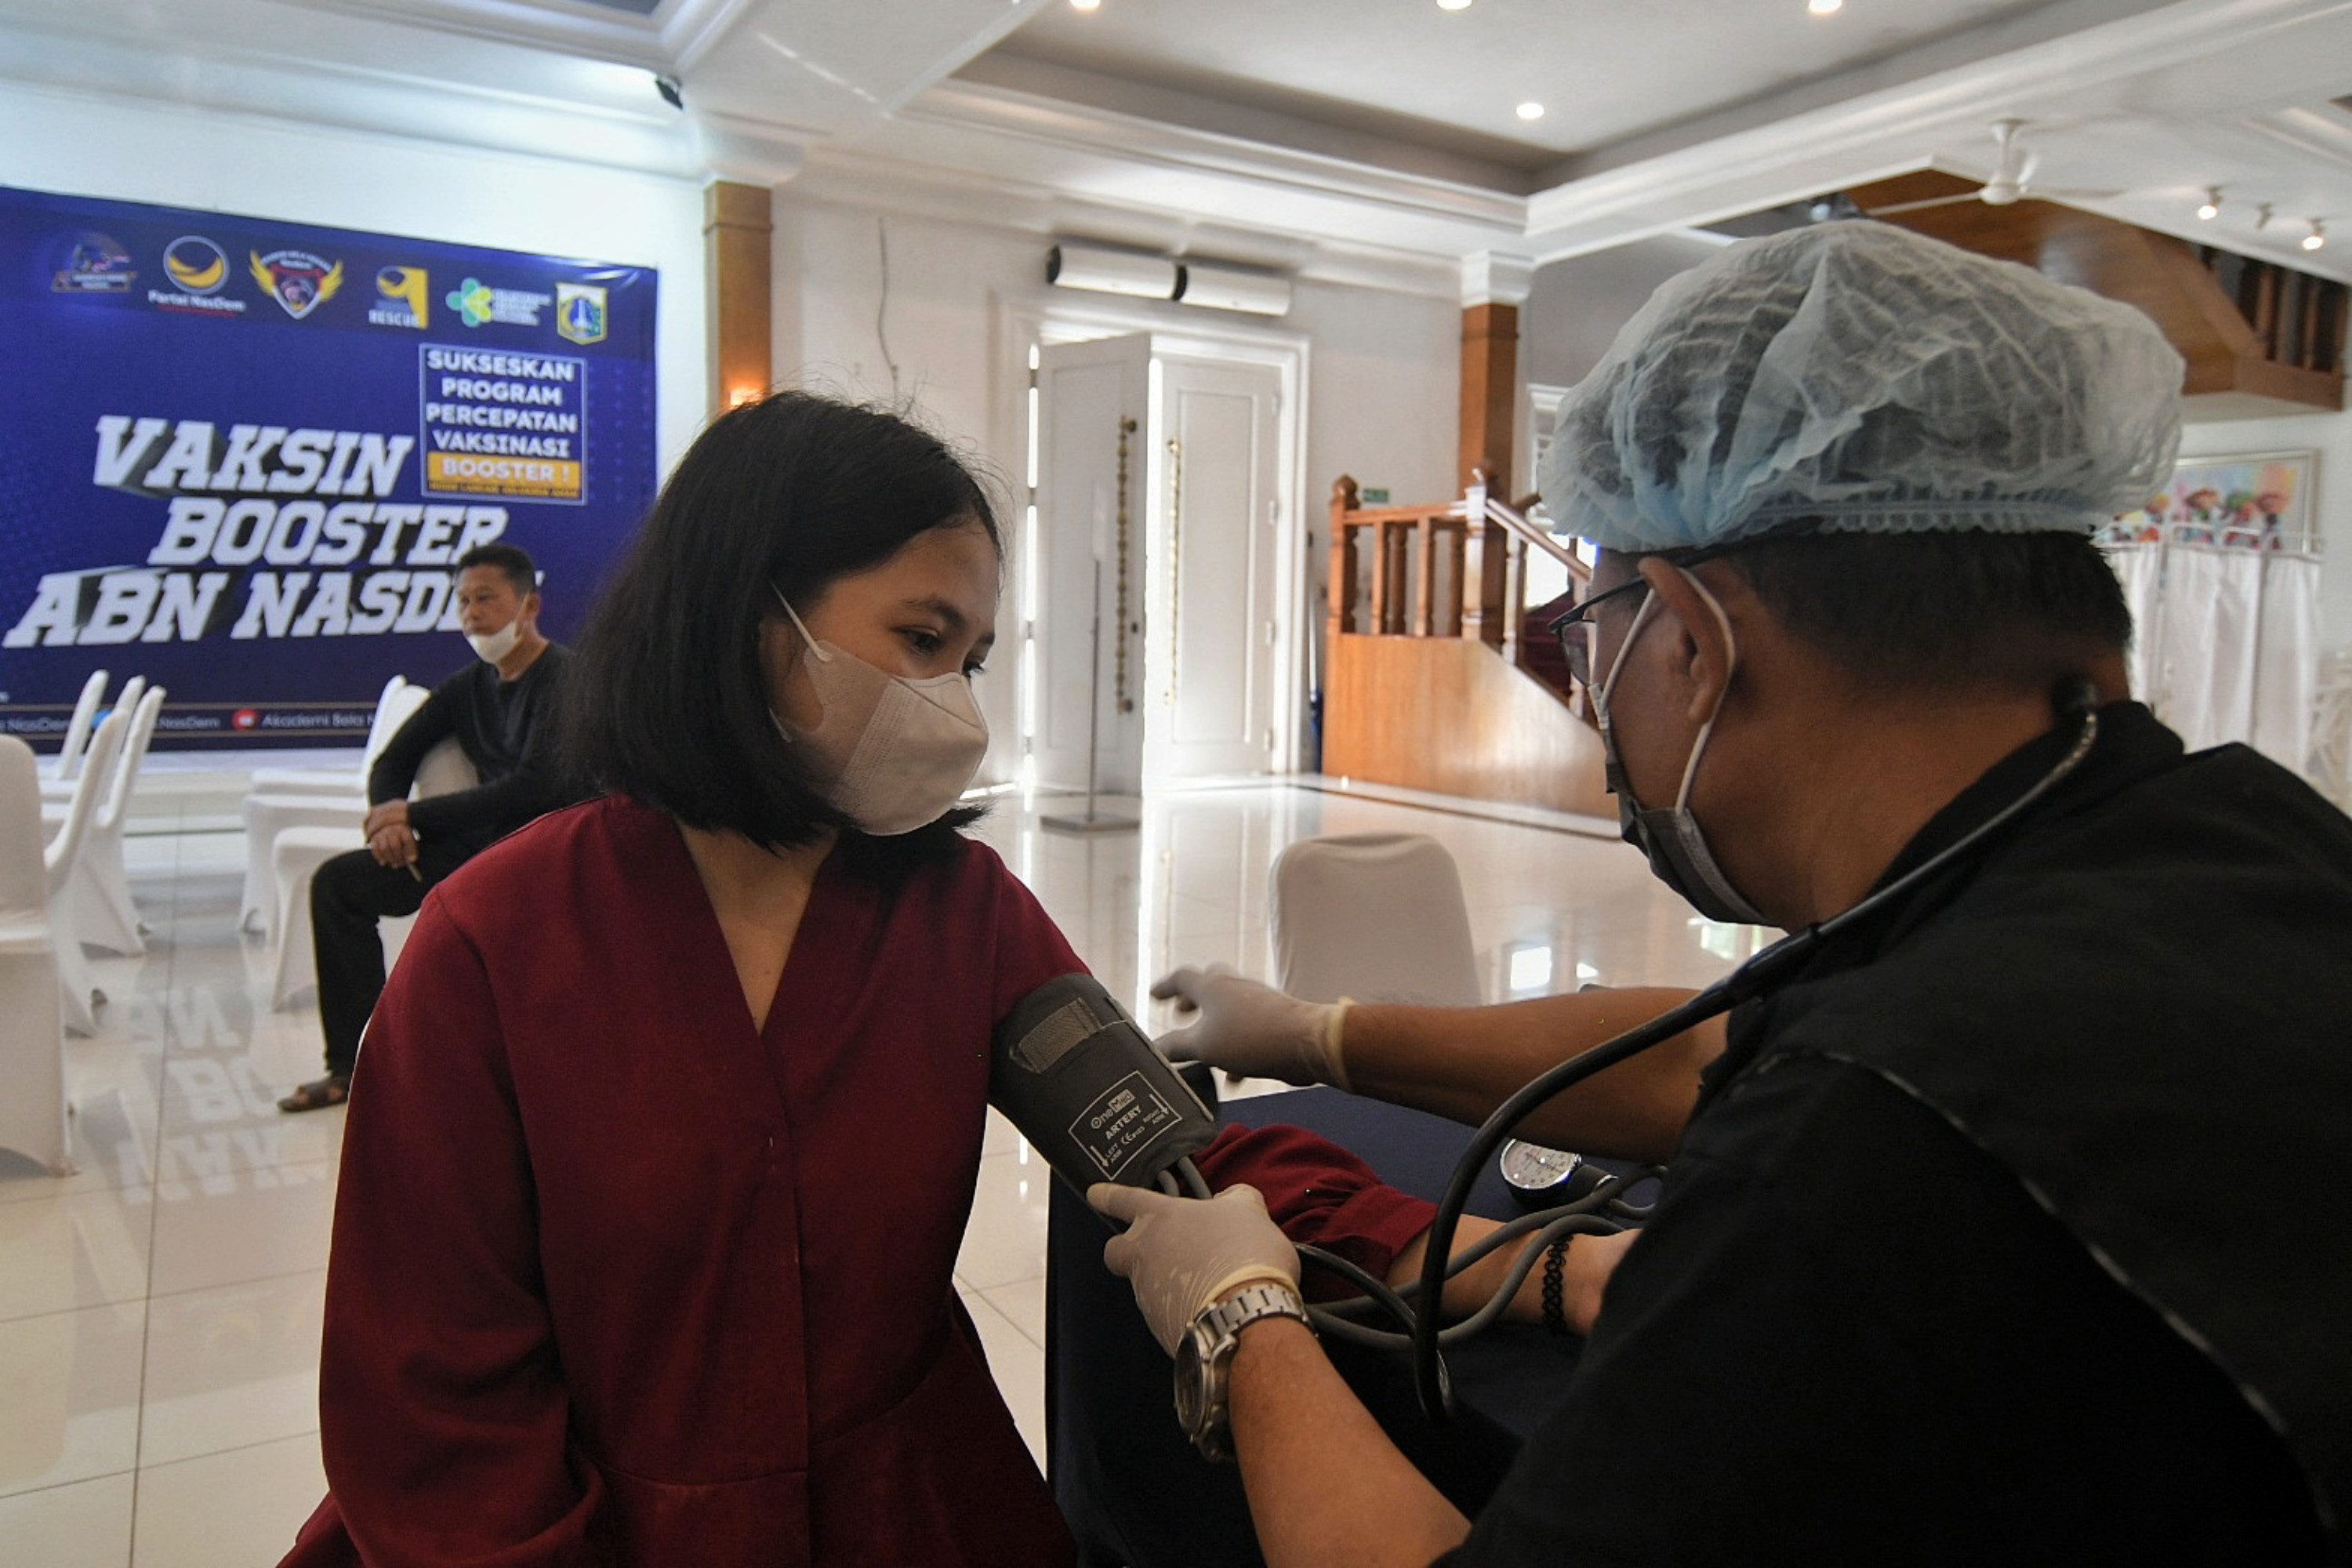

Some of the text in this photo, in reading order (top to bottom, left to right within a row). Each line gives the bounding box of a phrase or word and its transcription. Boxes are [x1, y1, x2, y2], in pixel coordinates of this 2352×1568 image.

[148, 289, 246, 311] Partai NasDem
[368, 309, 421, 327] RESCUE
[426, 350, 575, 382] SUKSESKAN
[441, 376, 564, 406] PROGRAM
[426, 402, 579, 434] PERCEPATAN
[93, 415, 416, 496] VAKSIN
[432, 429, 571, 459] VAKSINASI
[442, 457, 555, 481] BOOSTER
[147, 496, 509, 566] BOOSTER
[2, 570, 545, 648] ABN NASD
[262, 713, 328, 728] Akademi
[1105, 1105, 1142, 1140] ARTERY
